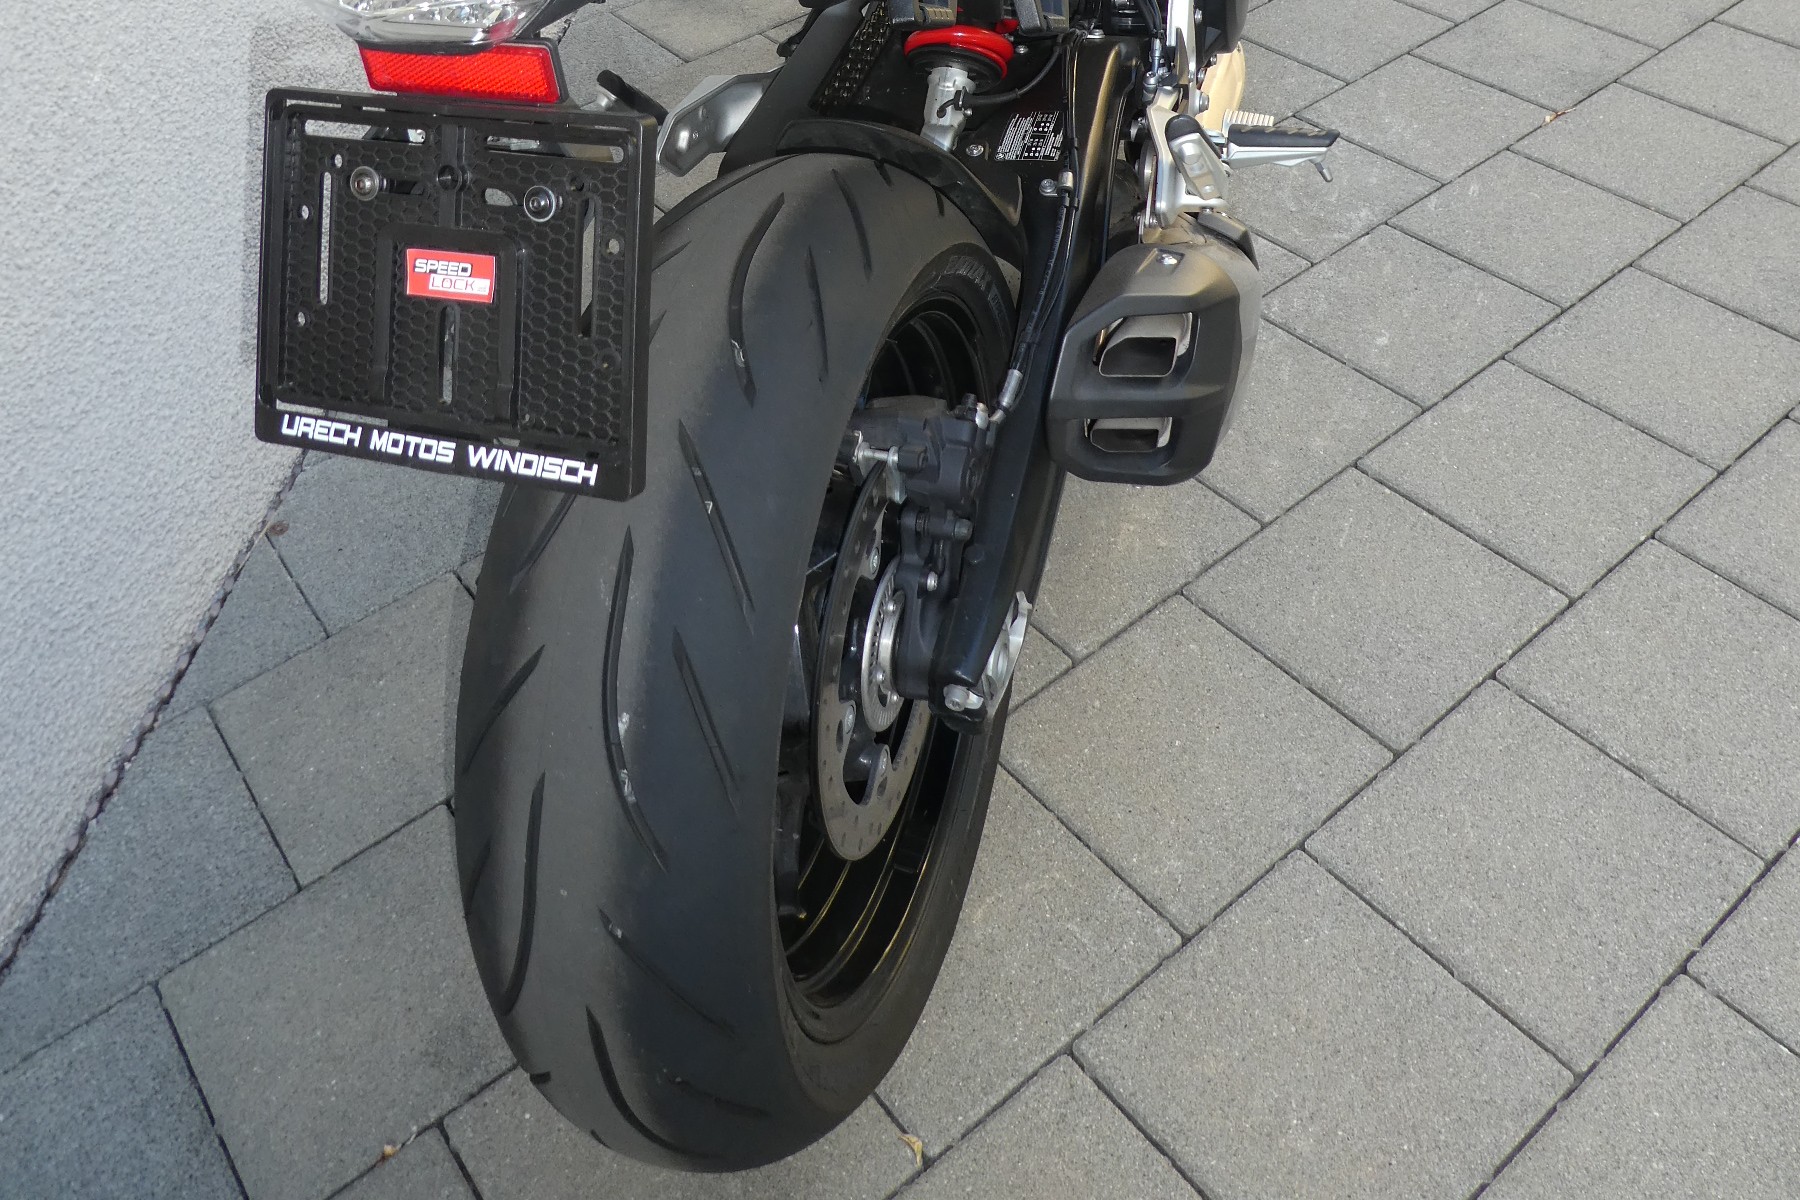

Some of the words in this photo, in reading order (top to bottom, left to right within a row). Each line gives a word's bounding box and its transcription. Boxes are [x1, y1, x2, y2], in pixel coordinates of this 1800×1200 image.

[414, 258, 473, 277] SPEED
[431, 276, 476, 291] LOCK
[280, 413, 362, 447] URECH
[369, 429, 457, 464] MOTOS
[467, 444, 599, 486] WINDISCH
